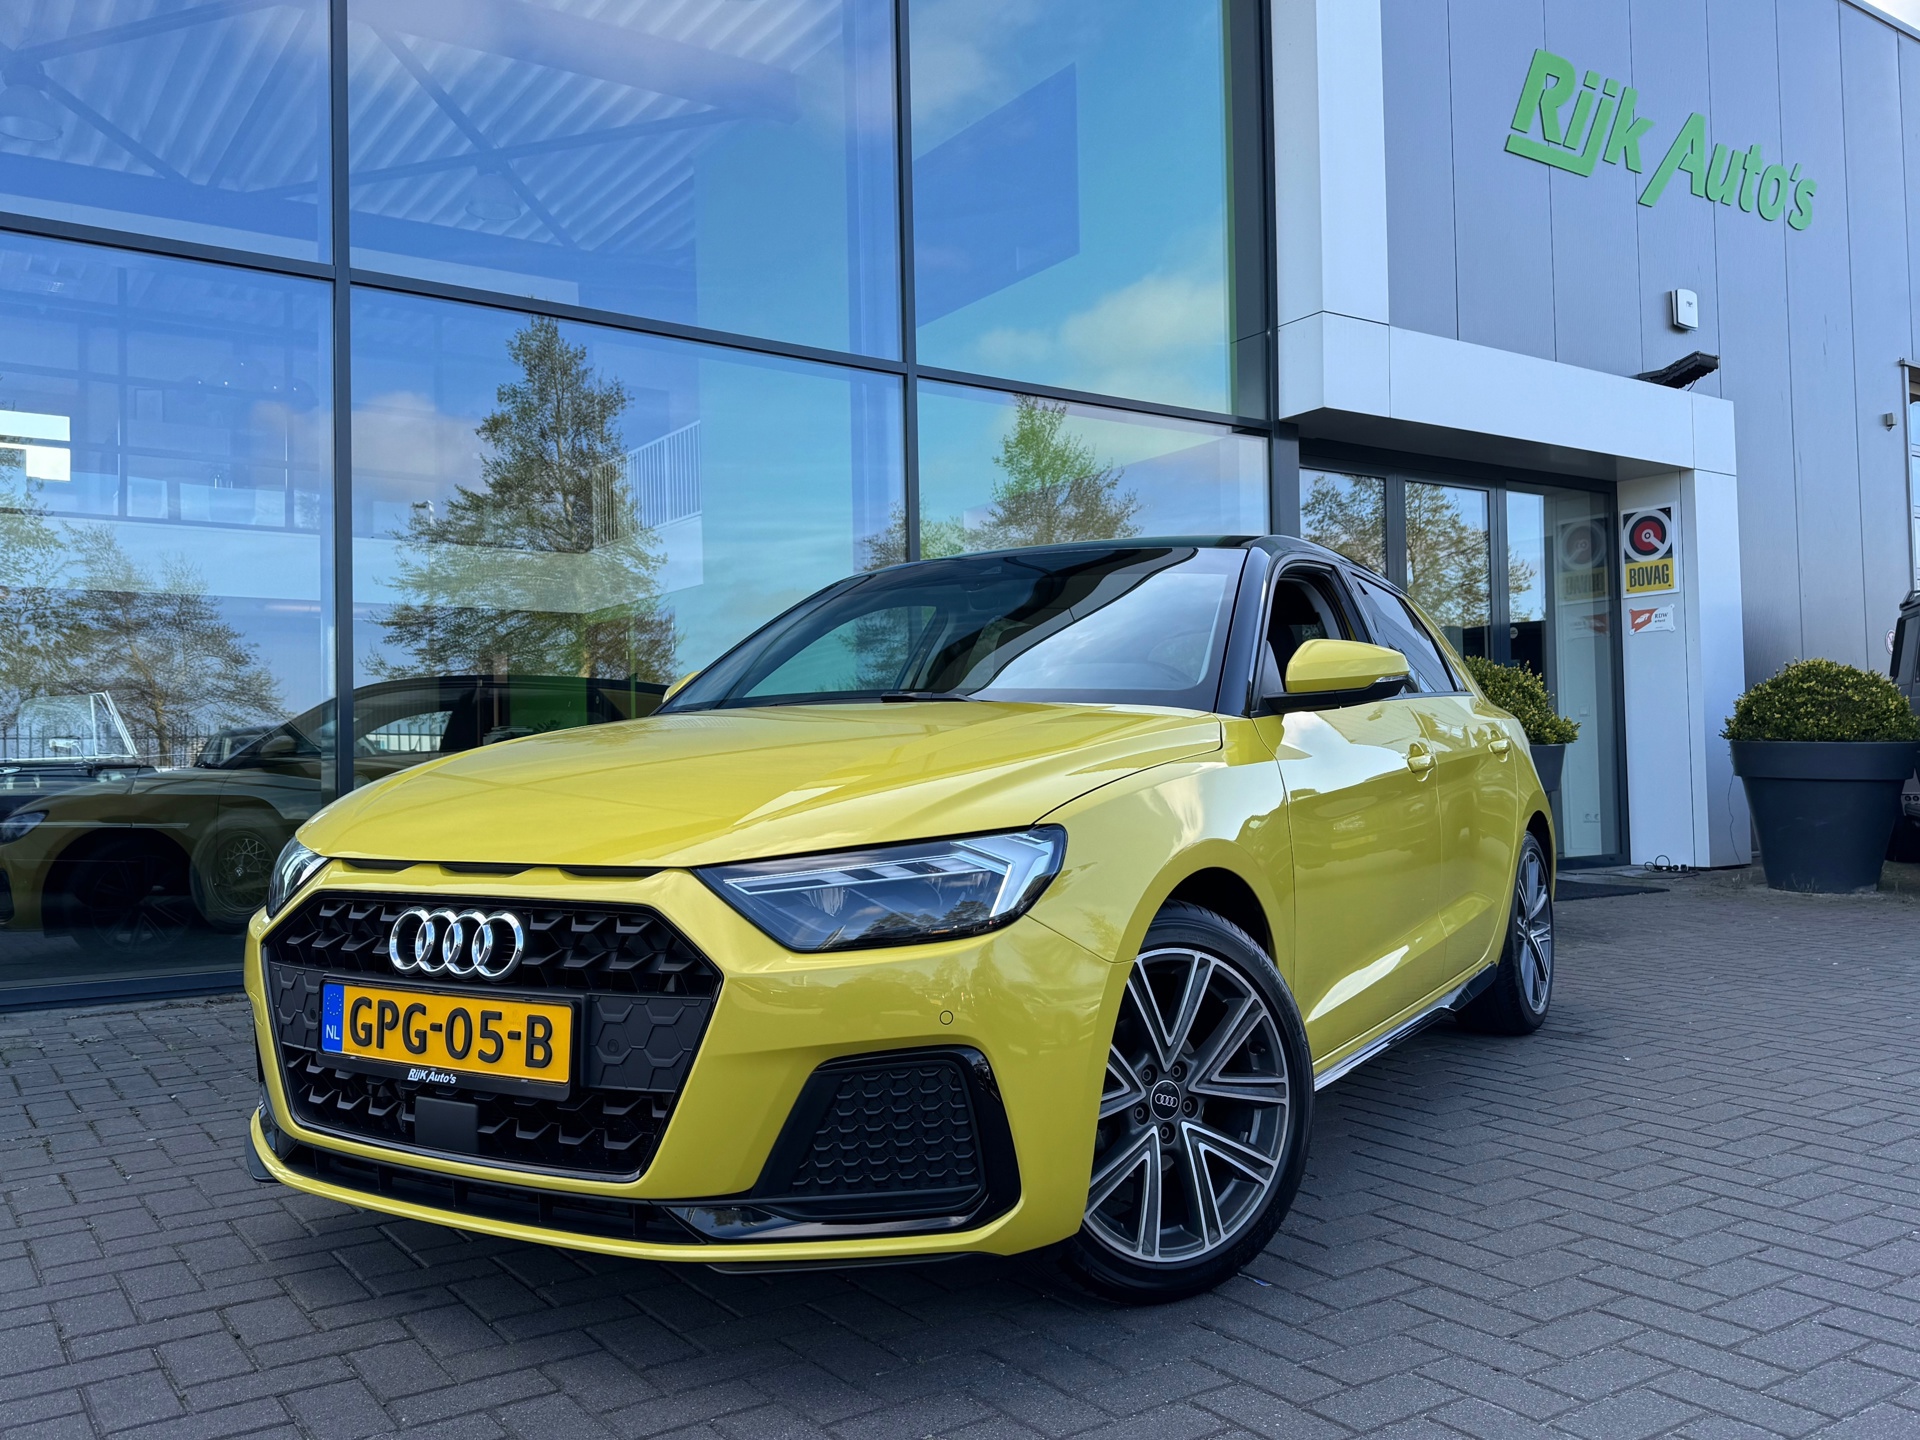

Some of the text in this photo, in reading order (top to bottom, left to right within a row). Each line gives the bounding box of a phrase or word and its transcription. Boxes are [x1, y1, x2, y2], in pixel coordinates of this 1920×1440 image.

[1504, 48, 1818, 231] Rijk Auto's
[1629, 563, 1670, 588] BOVAG
[325, 1024, 340, 1041] NL
[349, 996, 553, 1068] GPG-05-B
[426, 1071, 457, 1084] Auto's
